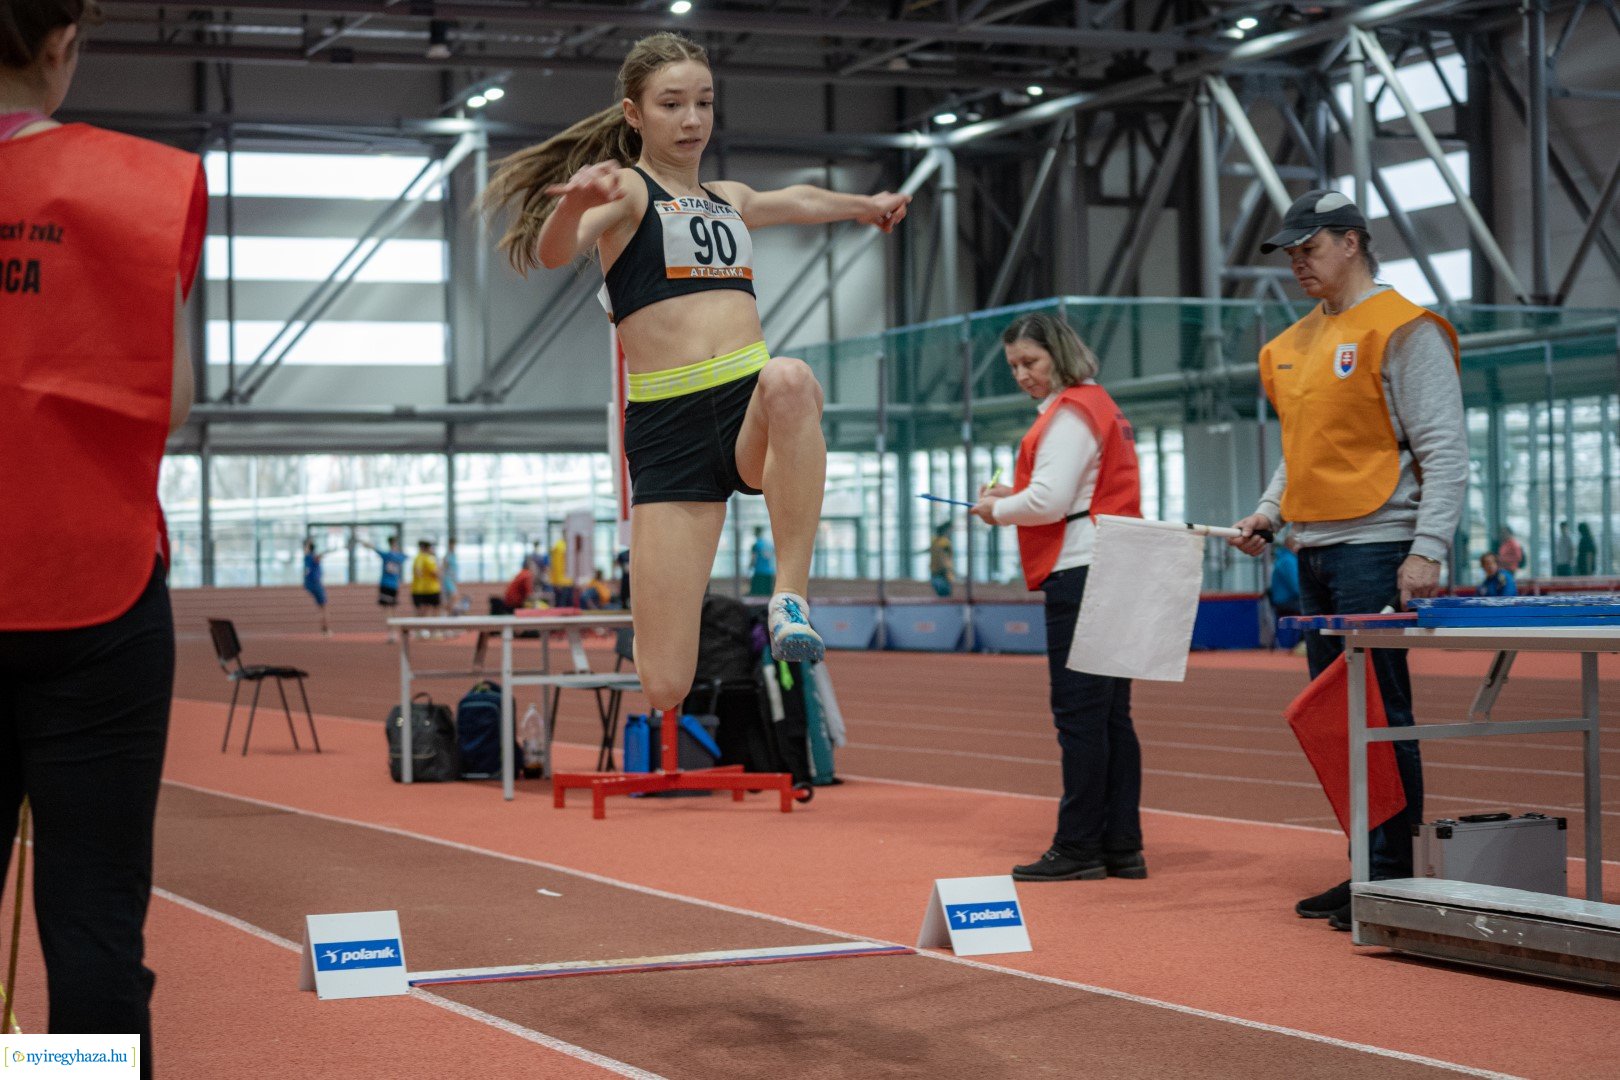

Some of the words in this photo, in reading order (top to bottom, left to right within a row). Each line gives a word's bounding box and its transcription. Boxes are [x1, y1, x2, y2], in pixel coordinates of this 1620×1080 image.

[689, 215, 737, 266] 90
[0, 258, 41, 293] CA
[690, 267, 744, 278] ATLETIKA
[968, 907, 1015, 924] polanik
[341, 946, 395, 964] polanik
